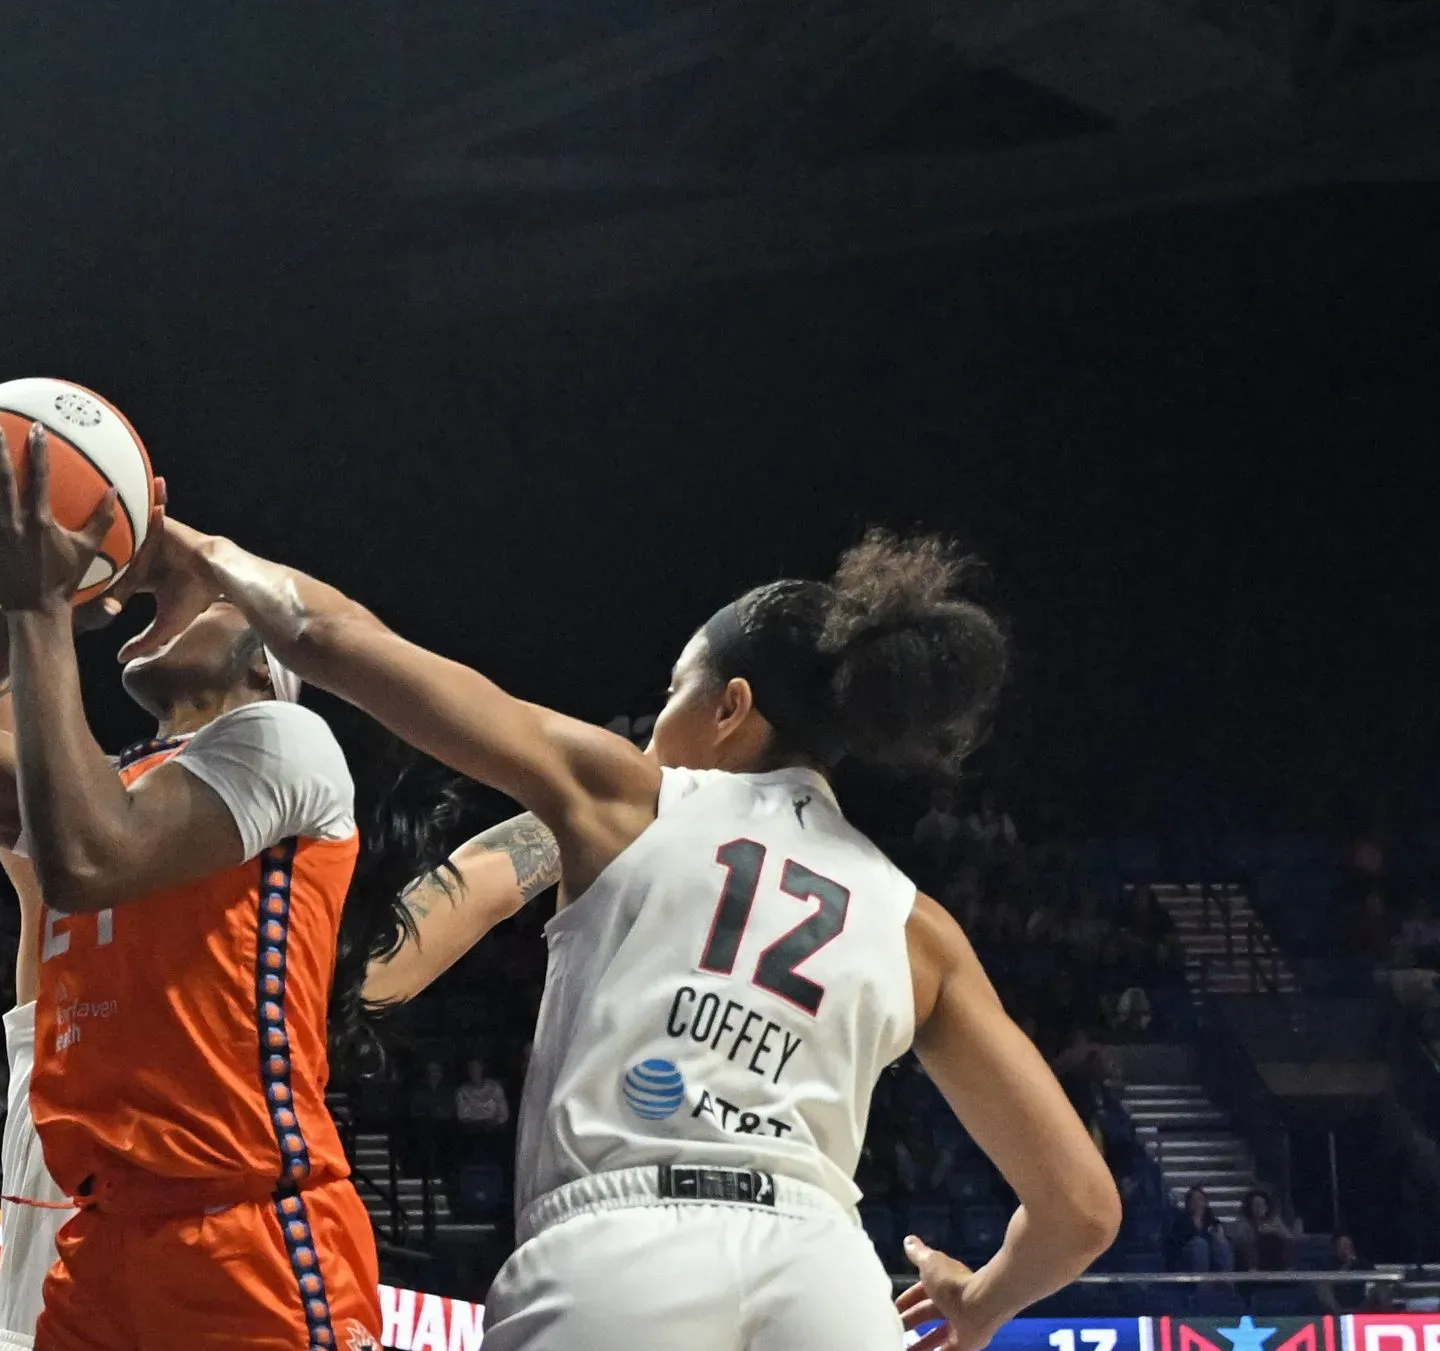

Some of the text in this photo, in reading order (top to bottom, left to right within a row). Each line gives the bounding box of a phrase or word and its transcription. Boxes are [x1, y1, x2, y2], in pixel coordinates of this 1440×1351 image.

[698, 837, 850, 1018] 12
[667, 987, 801, 1084] COFFEY
[691, 1090, 792, 1138] AT&T
